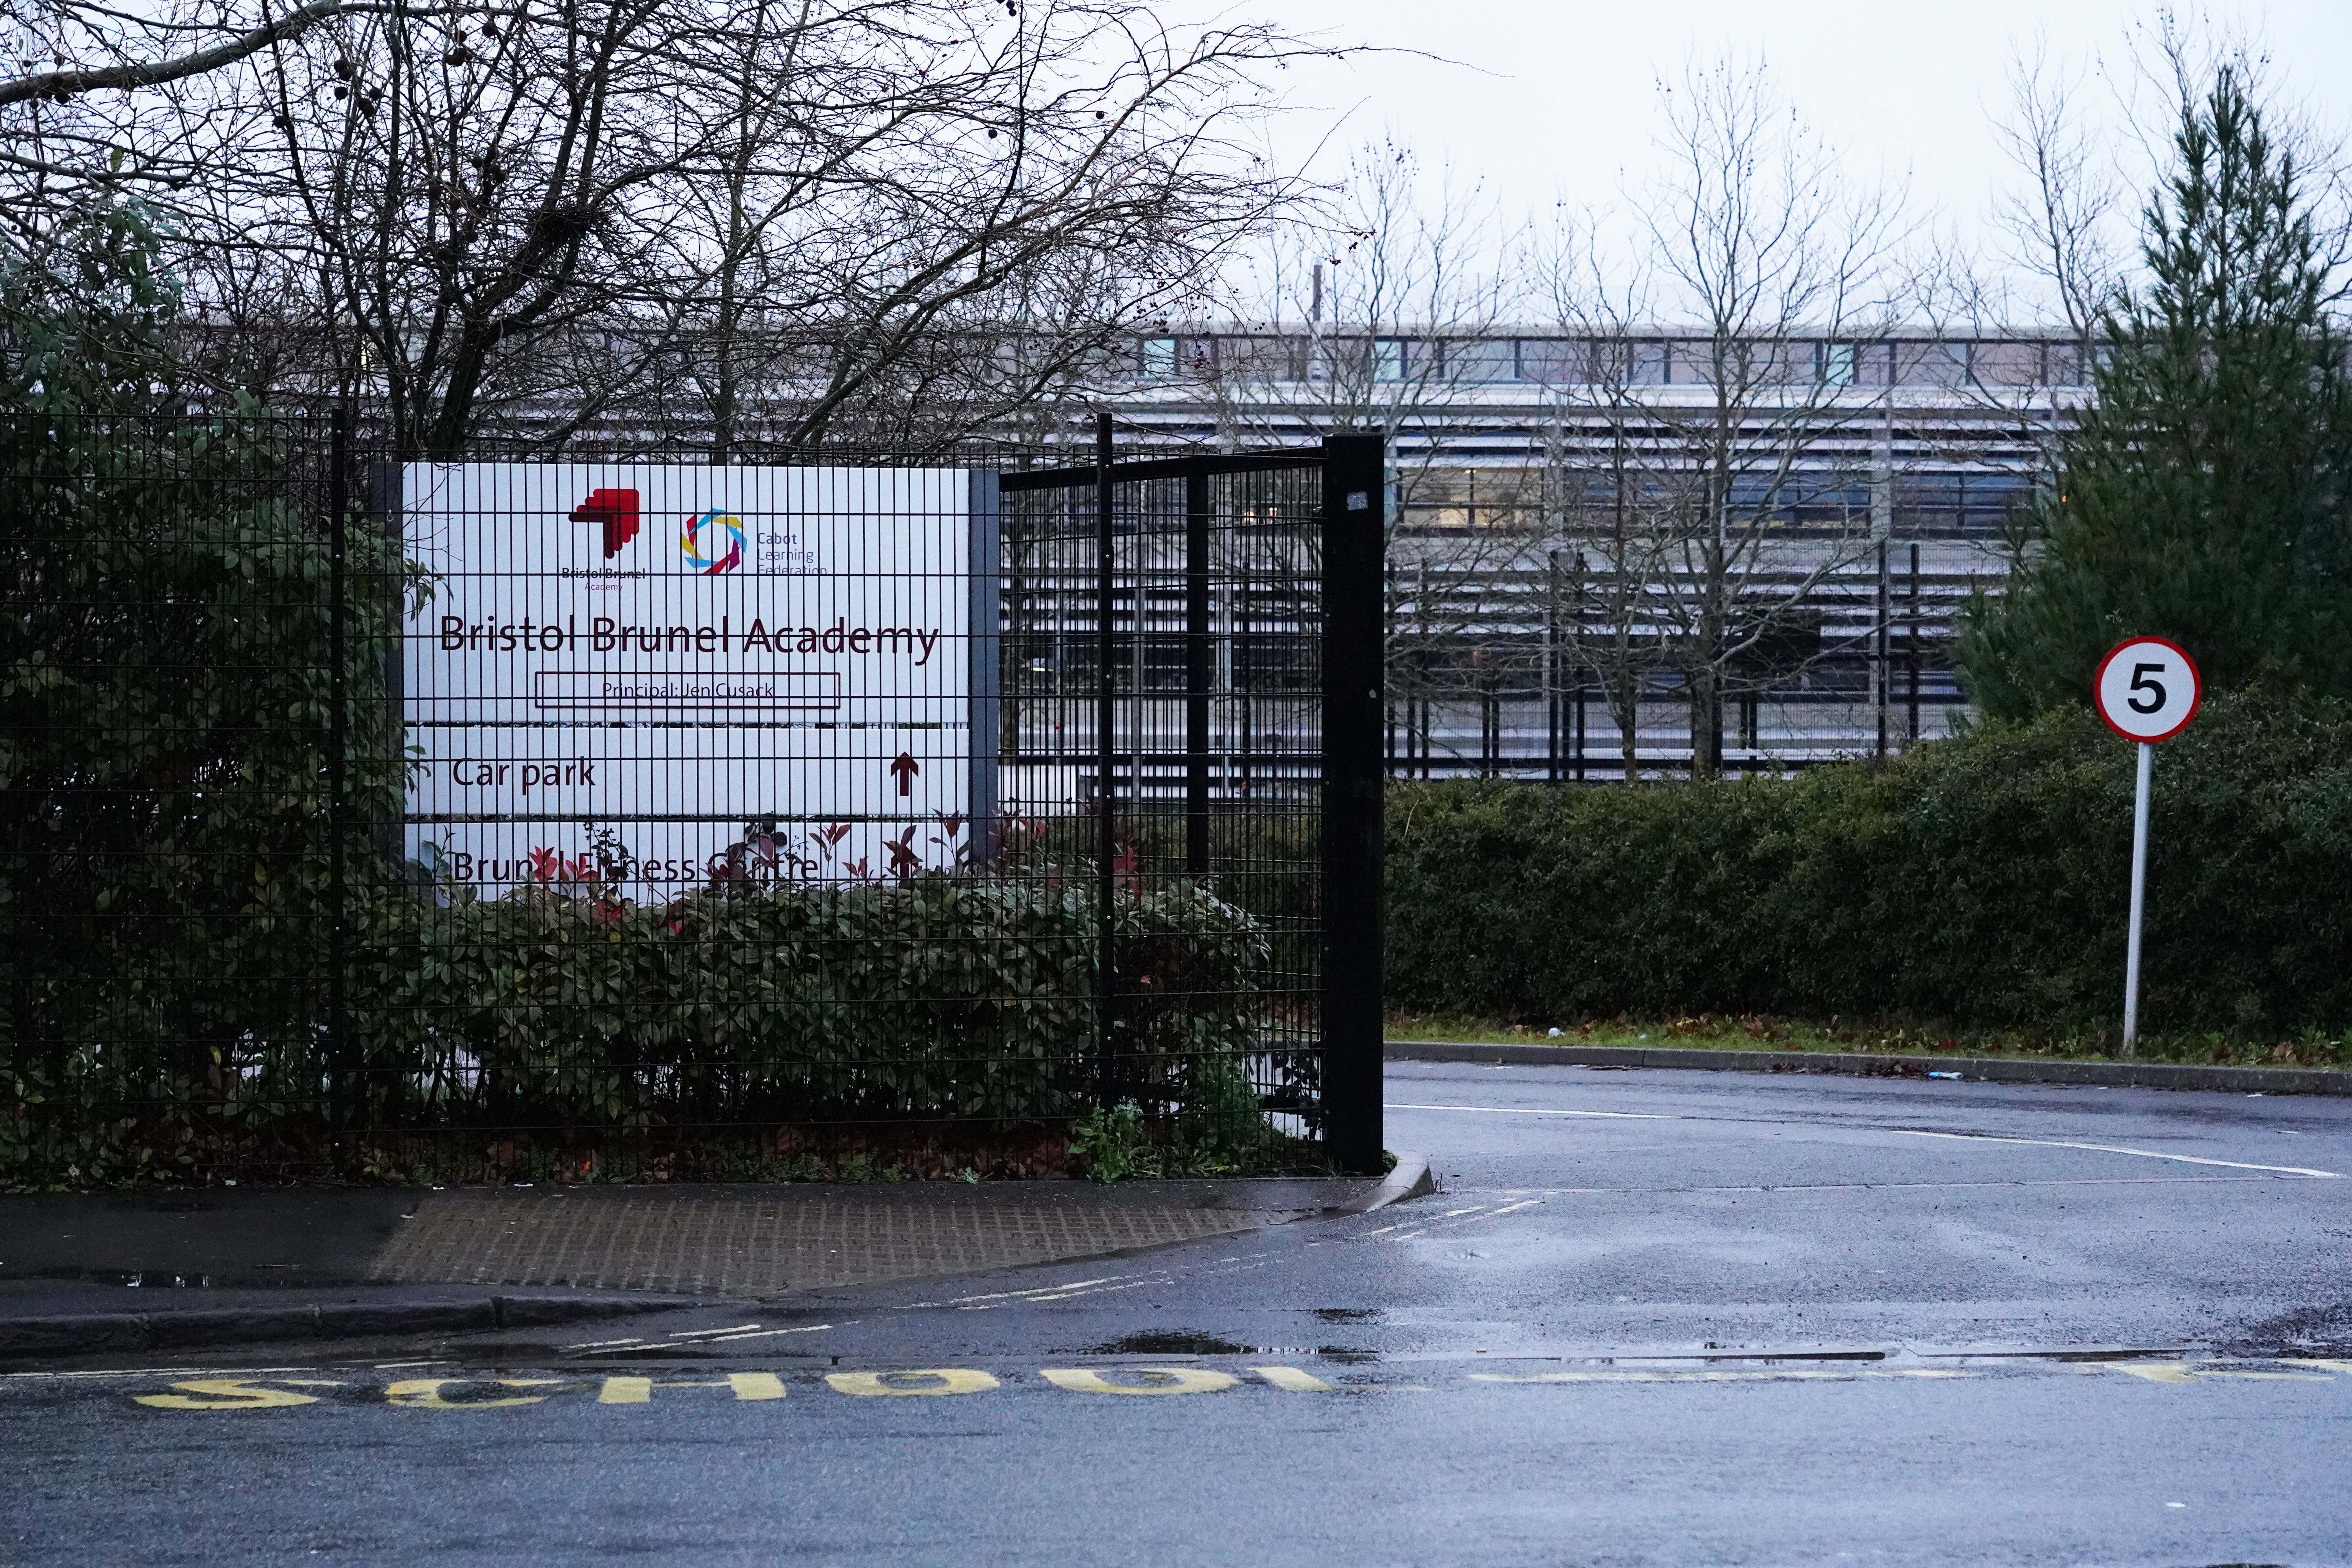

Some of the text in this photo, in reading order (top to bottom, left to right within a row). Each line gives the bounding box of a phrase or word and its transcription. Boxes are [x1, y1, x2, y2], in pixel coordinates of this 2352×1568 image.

[758, 532, 797, 544] Cabot
[758, 549, 814, 563] Learning
[562, 567, 645, 579] Bristol Brunel
[758, 565, 828, 575] Federation
[584, 583, 623, 593] Academy
[441, 614, 939, 666] Bristol Brunel Academy
[603, 683, 773, 701] Principal: Jen Cusack
[2127, 663, 2167, 714] 5
[453, 756, 596, 795] Car park
[455, 850, 564, 881] Brunl
[707, 853, 818, 879] Cntre
